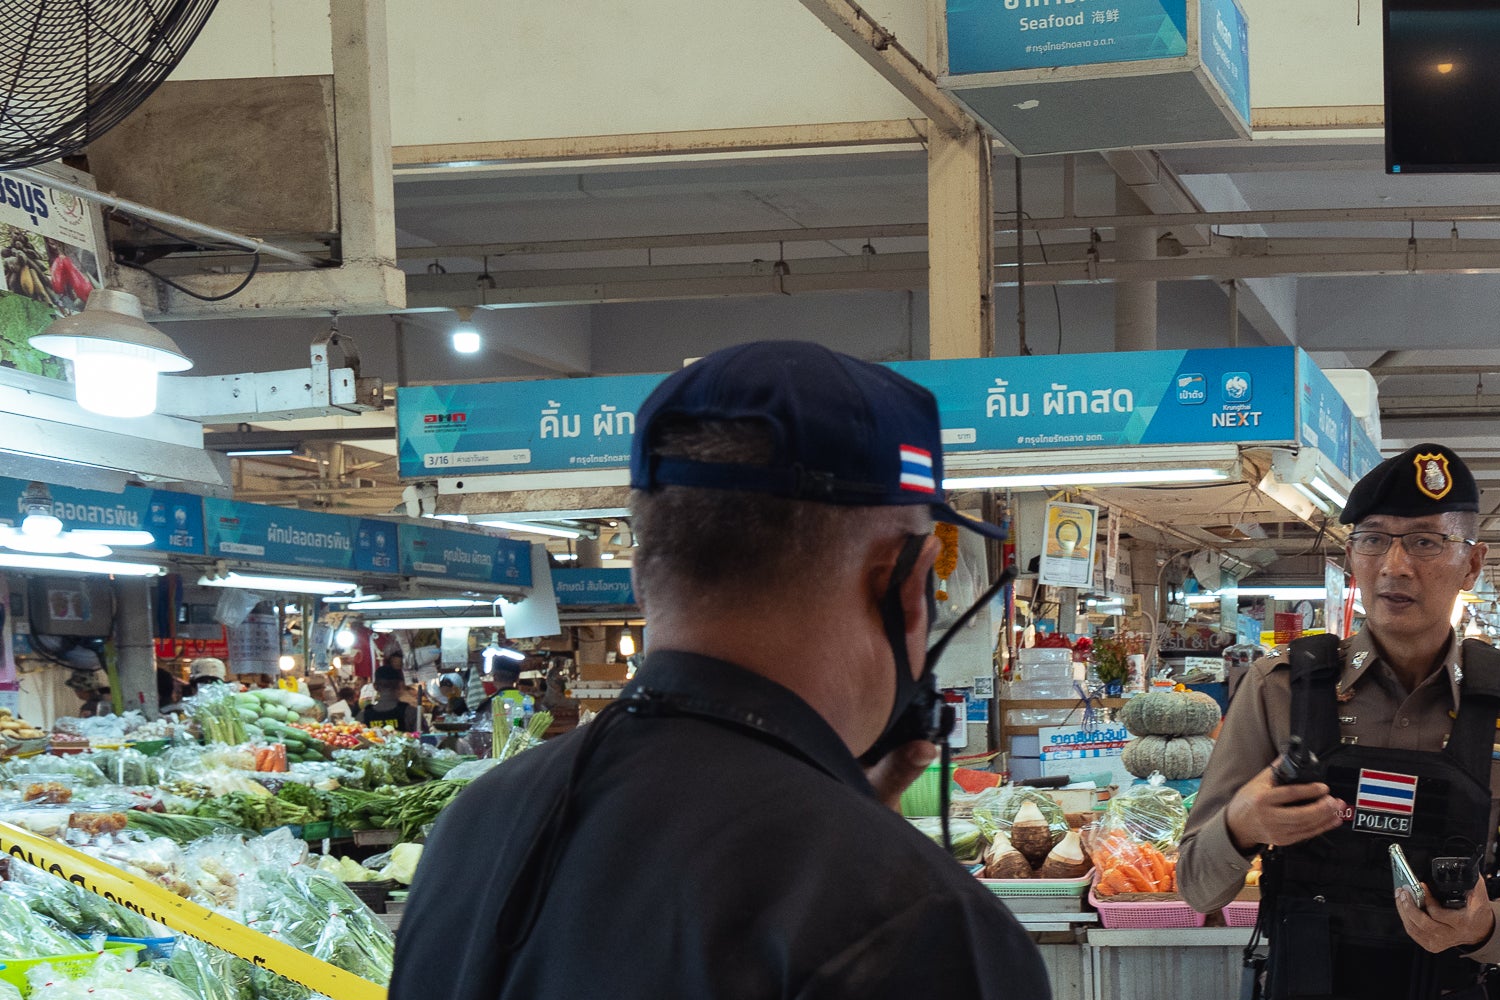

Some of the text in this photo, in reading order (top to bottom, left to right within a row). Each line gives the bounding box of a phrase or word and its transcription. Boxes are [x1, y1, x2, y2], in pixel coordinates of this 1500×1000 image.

[1020, 11, 1084, 31] Seafood
[1091, 8, 1120, 25] 海鲜
[985, 378, 1134, 418] คิ้ม ผักสด
[1222, 403, 1252, 413] Krungthai
[540, 400, 581, 439] คิ้ม
[1211, 411, 1262, 428] NEXT
[428, 455, 449, 466] 3/16
[169, 534, 194, 548] NEXT
[1357, 812, 1409, 832] POLICE
